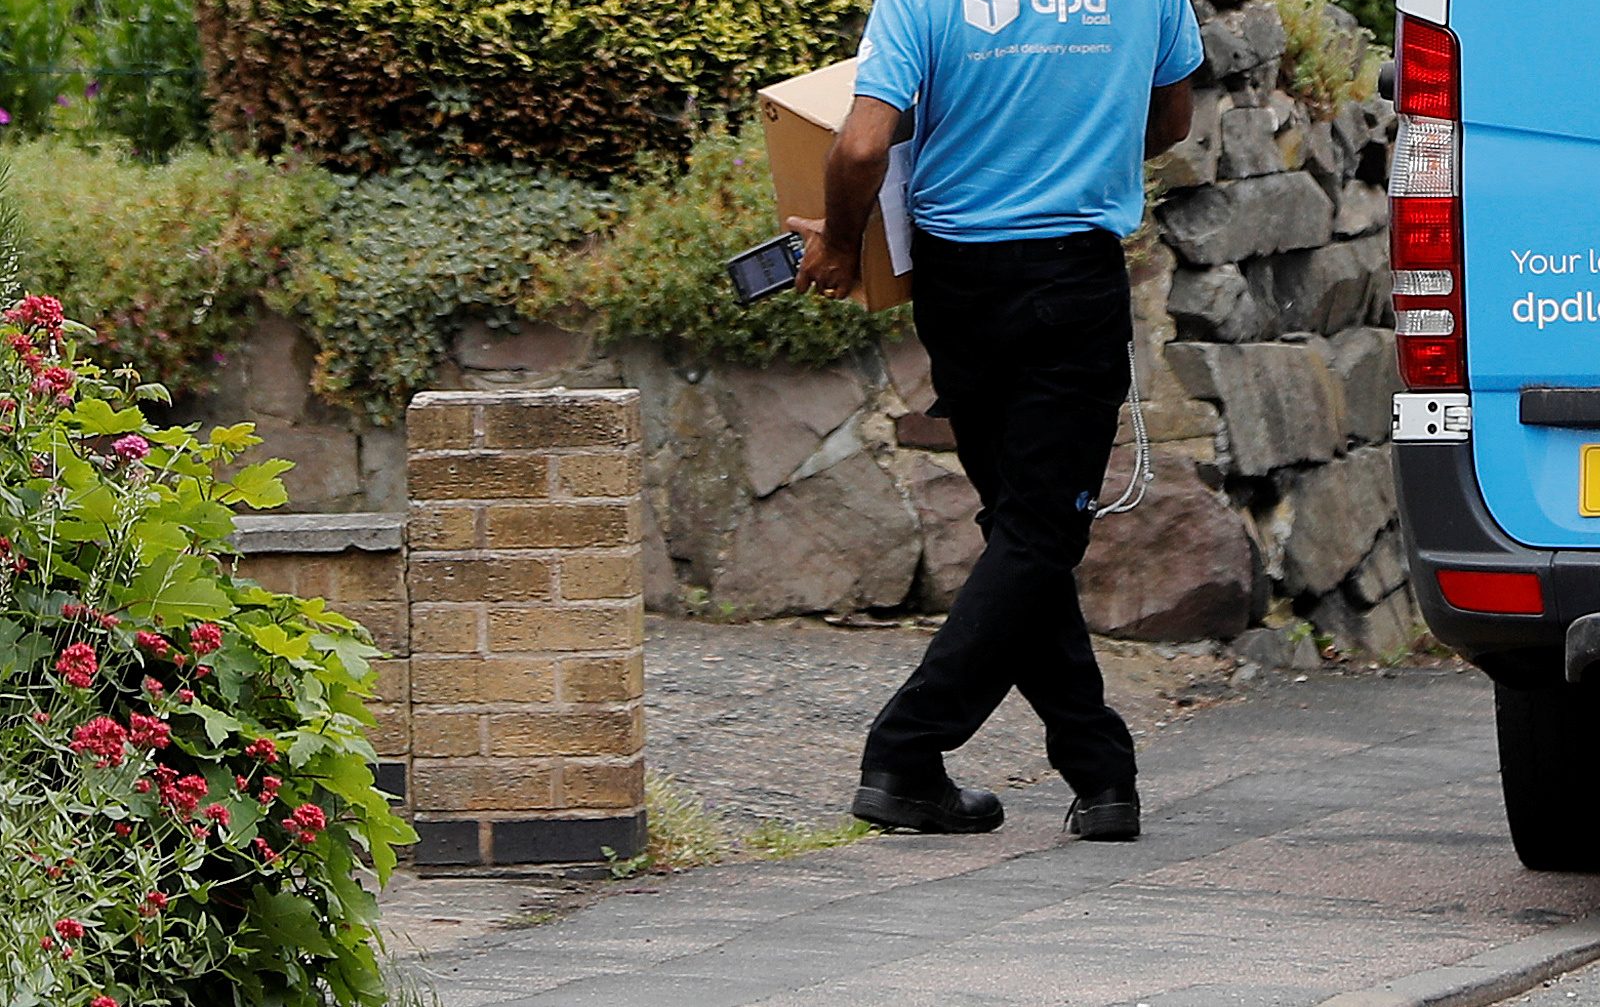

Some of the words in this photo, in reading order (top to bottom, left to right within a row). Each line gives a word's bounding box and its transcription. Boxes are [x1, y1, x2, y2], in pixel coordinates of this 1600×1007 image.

[1082, 14, 1111, 25] local
[967, 49, 993, 61] Your
[1021, 43, 1067, 55] delivery
[1069, 43, 1112, 55] experts
[1511, 249, 1581, 274] Your
